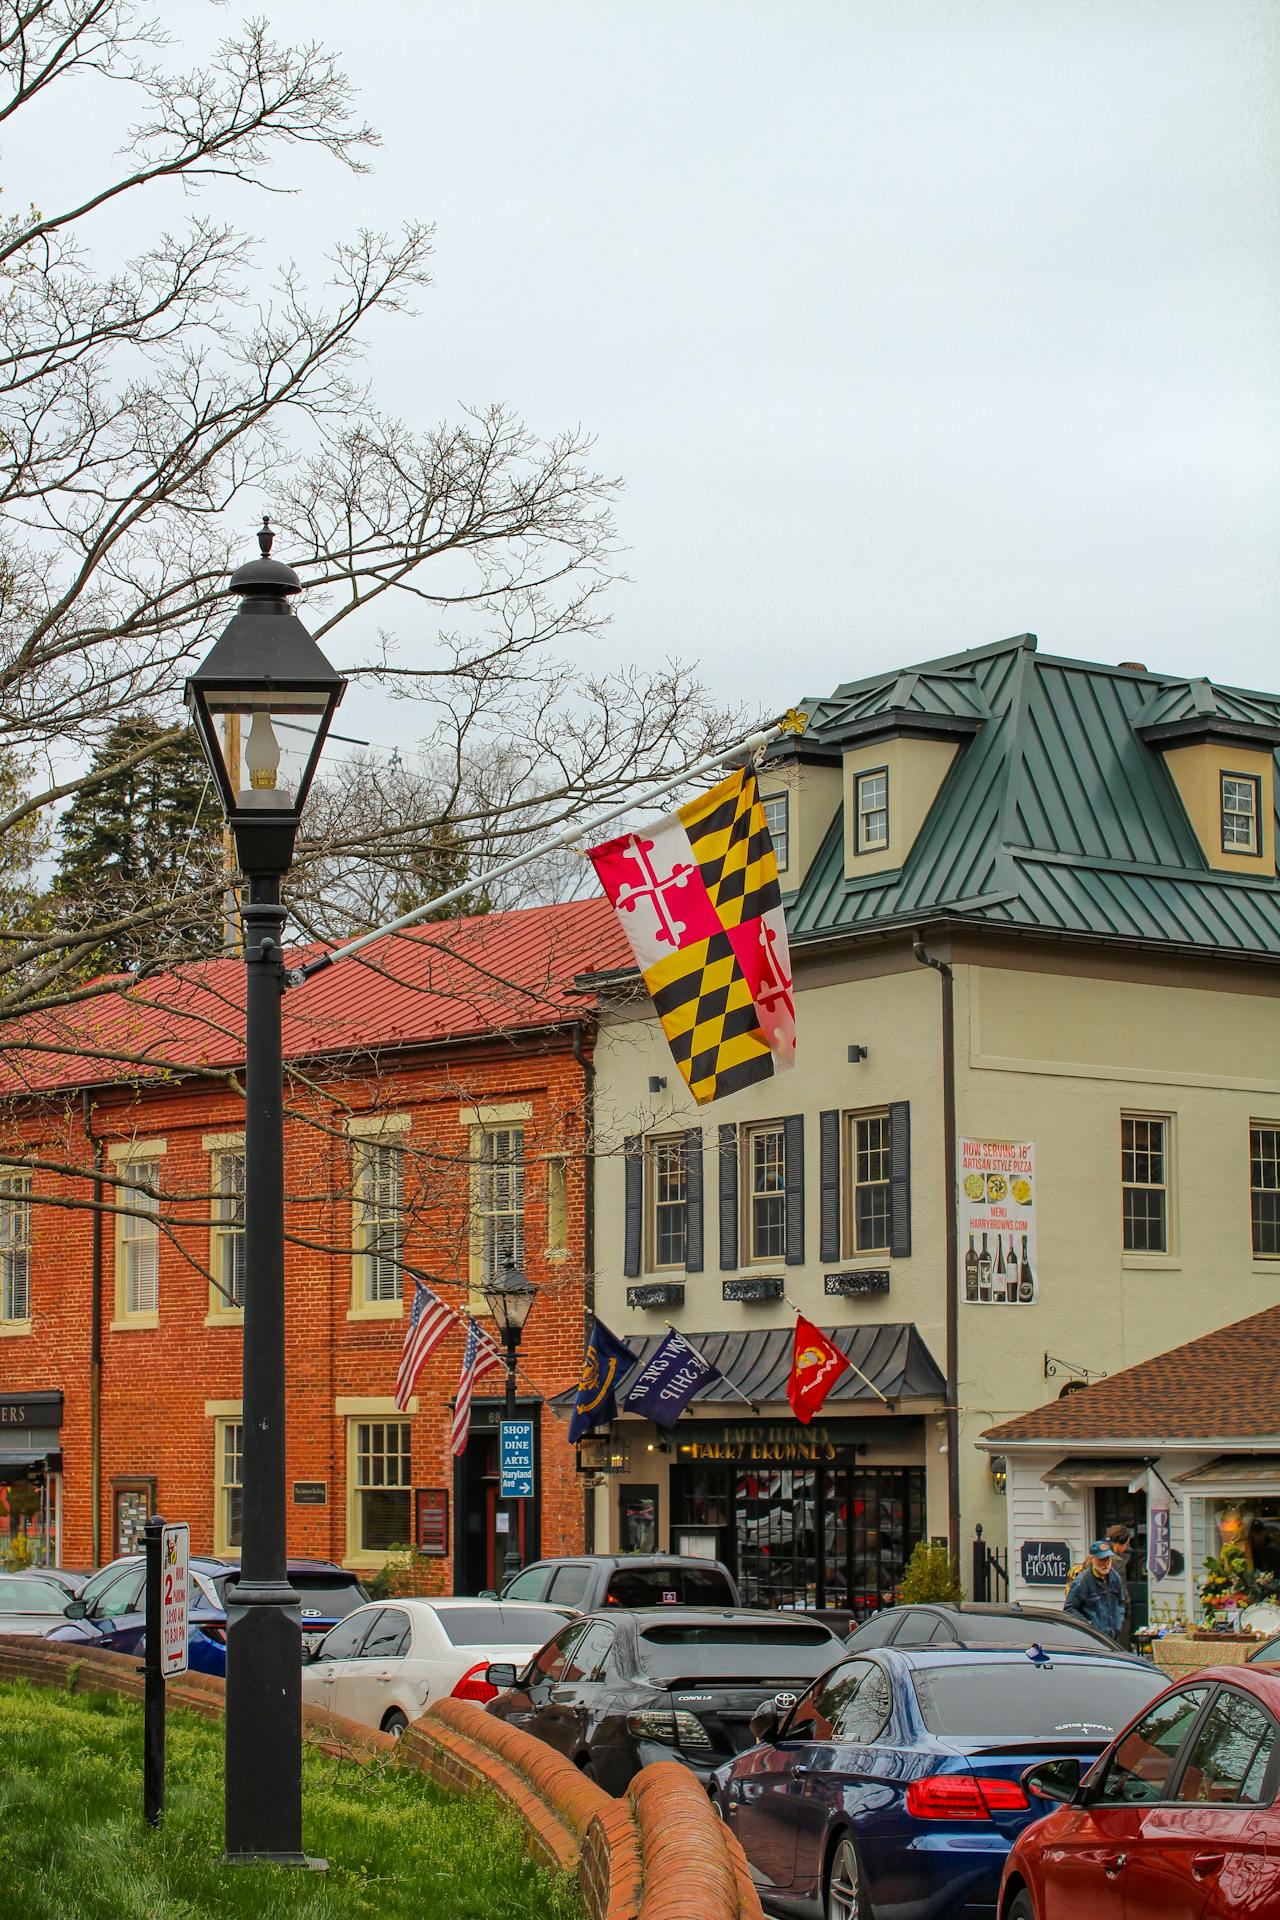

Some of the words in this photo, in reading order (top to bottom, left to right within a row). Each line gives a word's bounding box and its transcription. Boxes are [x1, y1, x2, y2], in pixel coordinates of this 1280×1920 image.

[963, 1142, 981, 1157] NOW
[982, 1143, 1016, 1159] SERVING
[963, 1157, 991, 1170] ARTISAN
[992, 1159, 1012, 1172] STYLE
[1013, 1160, 1032, 1173] PIZZA
[990, 1207, 1007, 1217] MENU
[969, 1218, 1028, 1231] HARRYBROWNS.COM
[503, 1426, 530, 1435] SHOP
[504, 1441, 529, 1450] DINE
[691, 1440, 745, 1460] HARRY
[504, 1456, 529, 1465] ARTS
[502, 1470, 532, 1480] Maryland
[503, 1480, 515, 1488] Ave
[1154, 1512, 1169, 1573] OPEN
[1027, 1543, 1063, 1563] welcome
[1025, 1561, 1067, 1577] HOME
[165, 1574, 172, 1605] 2
